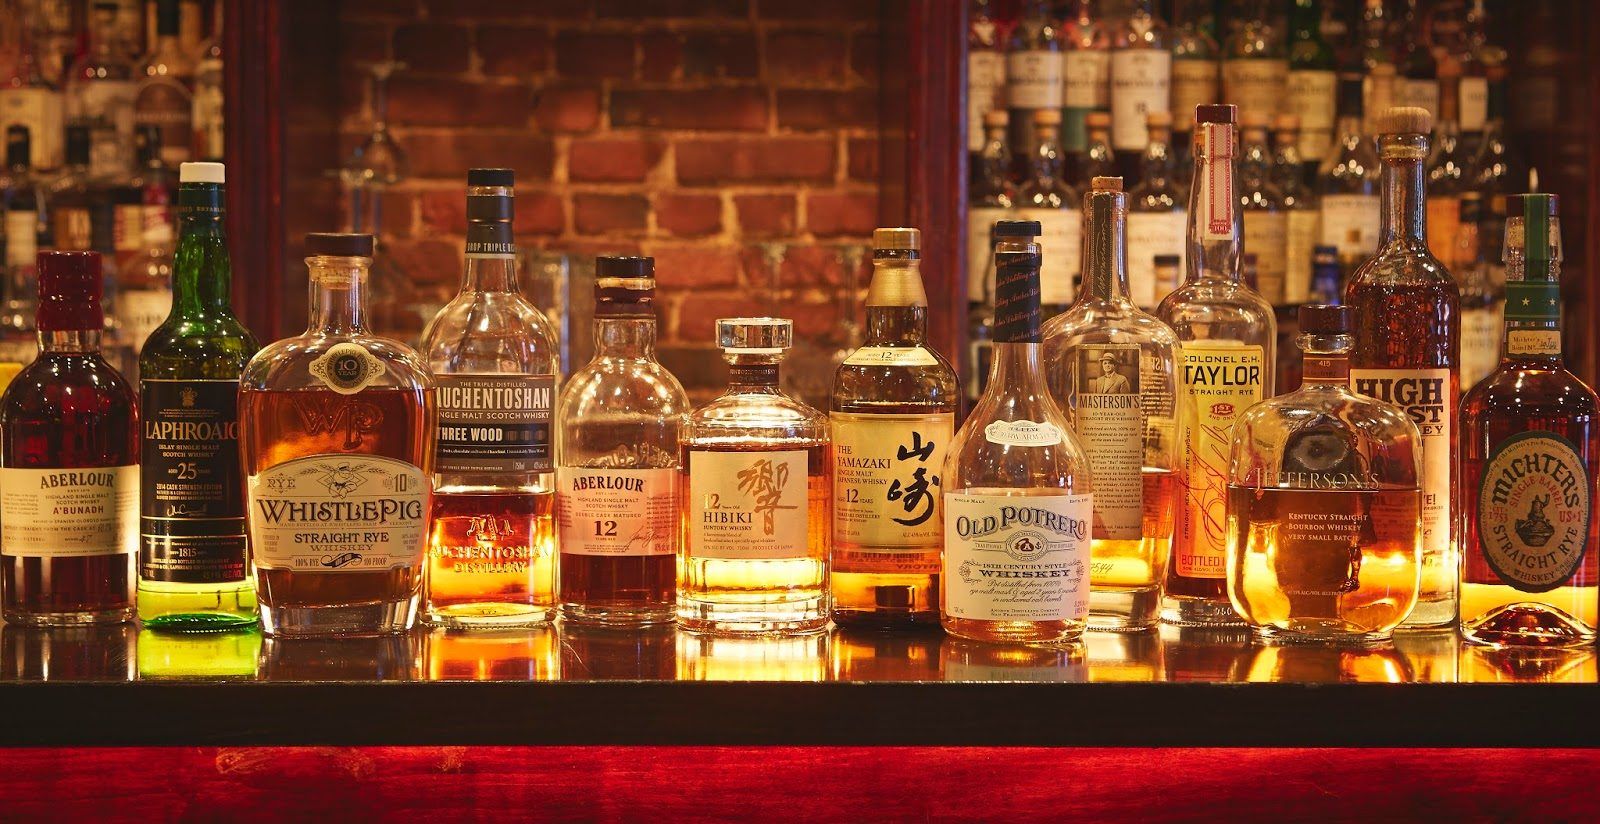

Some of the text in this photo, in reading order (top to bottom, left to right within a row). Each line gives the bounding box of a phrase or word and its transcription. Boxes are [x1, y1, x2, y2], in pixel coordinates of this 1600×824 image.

[484, 242, 506, 252] TRIPLE
[338, 360, 358, 370] 10
[1184, 366, 1260, 386] TAYLOR
[1356, 378, 1444, 404] HIGH
[1080, 396, 1139, 408] MASTERSON'S
[470, 428, 503, 442] WOOD
[838, 445, 852, 454] THE
[837, 457, 891, 469] YAMAZAKI
[177, 462, 197, 479] 25
[40, 472, 114, 489] ABERLOUR
[267, 478, 296, 488] RYE
[394, 474, 407, 492] 10
[573, 476, 644, 492] ABERLOUR
[1254, 468, 1379, 492] JEFFERSON'S
[1492, 453, 1579, 508] MICHTER'S
[846, 488, 859, 503] 12
[1510, 476, 1562, 508] SINGLE BARREL
[704, 493, 720, 509] 12
[53, 506, 104, 515] A'BUNADH
[704, 512, 752, 523] HIBIKI
[594, 520, 617, 536] 12
[956, 506, 1086, 541] OLD POTRERO
[294, 532, 389, 544] STRAIGHT RYE
[179, 548, 196, 557] 1815
[1493, 524, 1578, 568] STRAIGHT RYE
[1182, 554, 1219, 566] BOTTLED
[979, 569, 1071, 578] WHISKEY
[1514, 570, 1555, 581] WHISKEY
